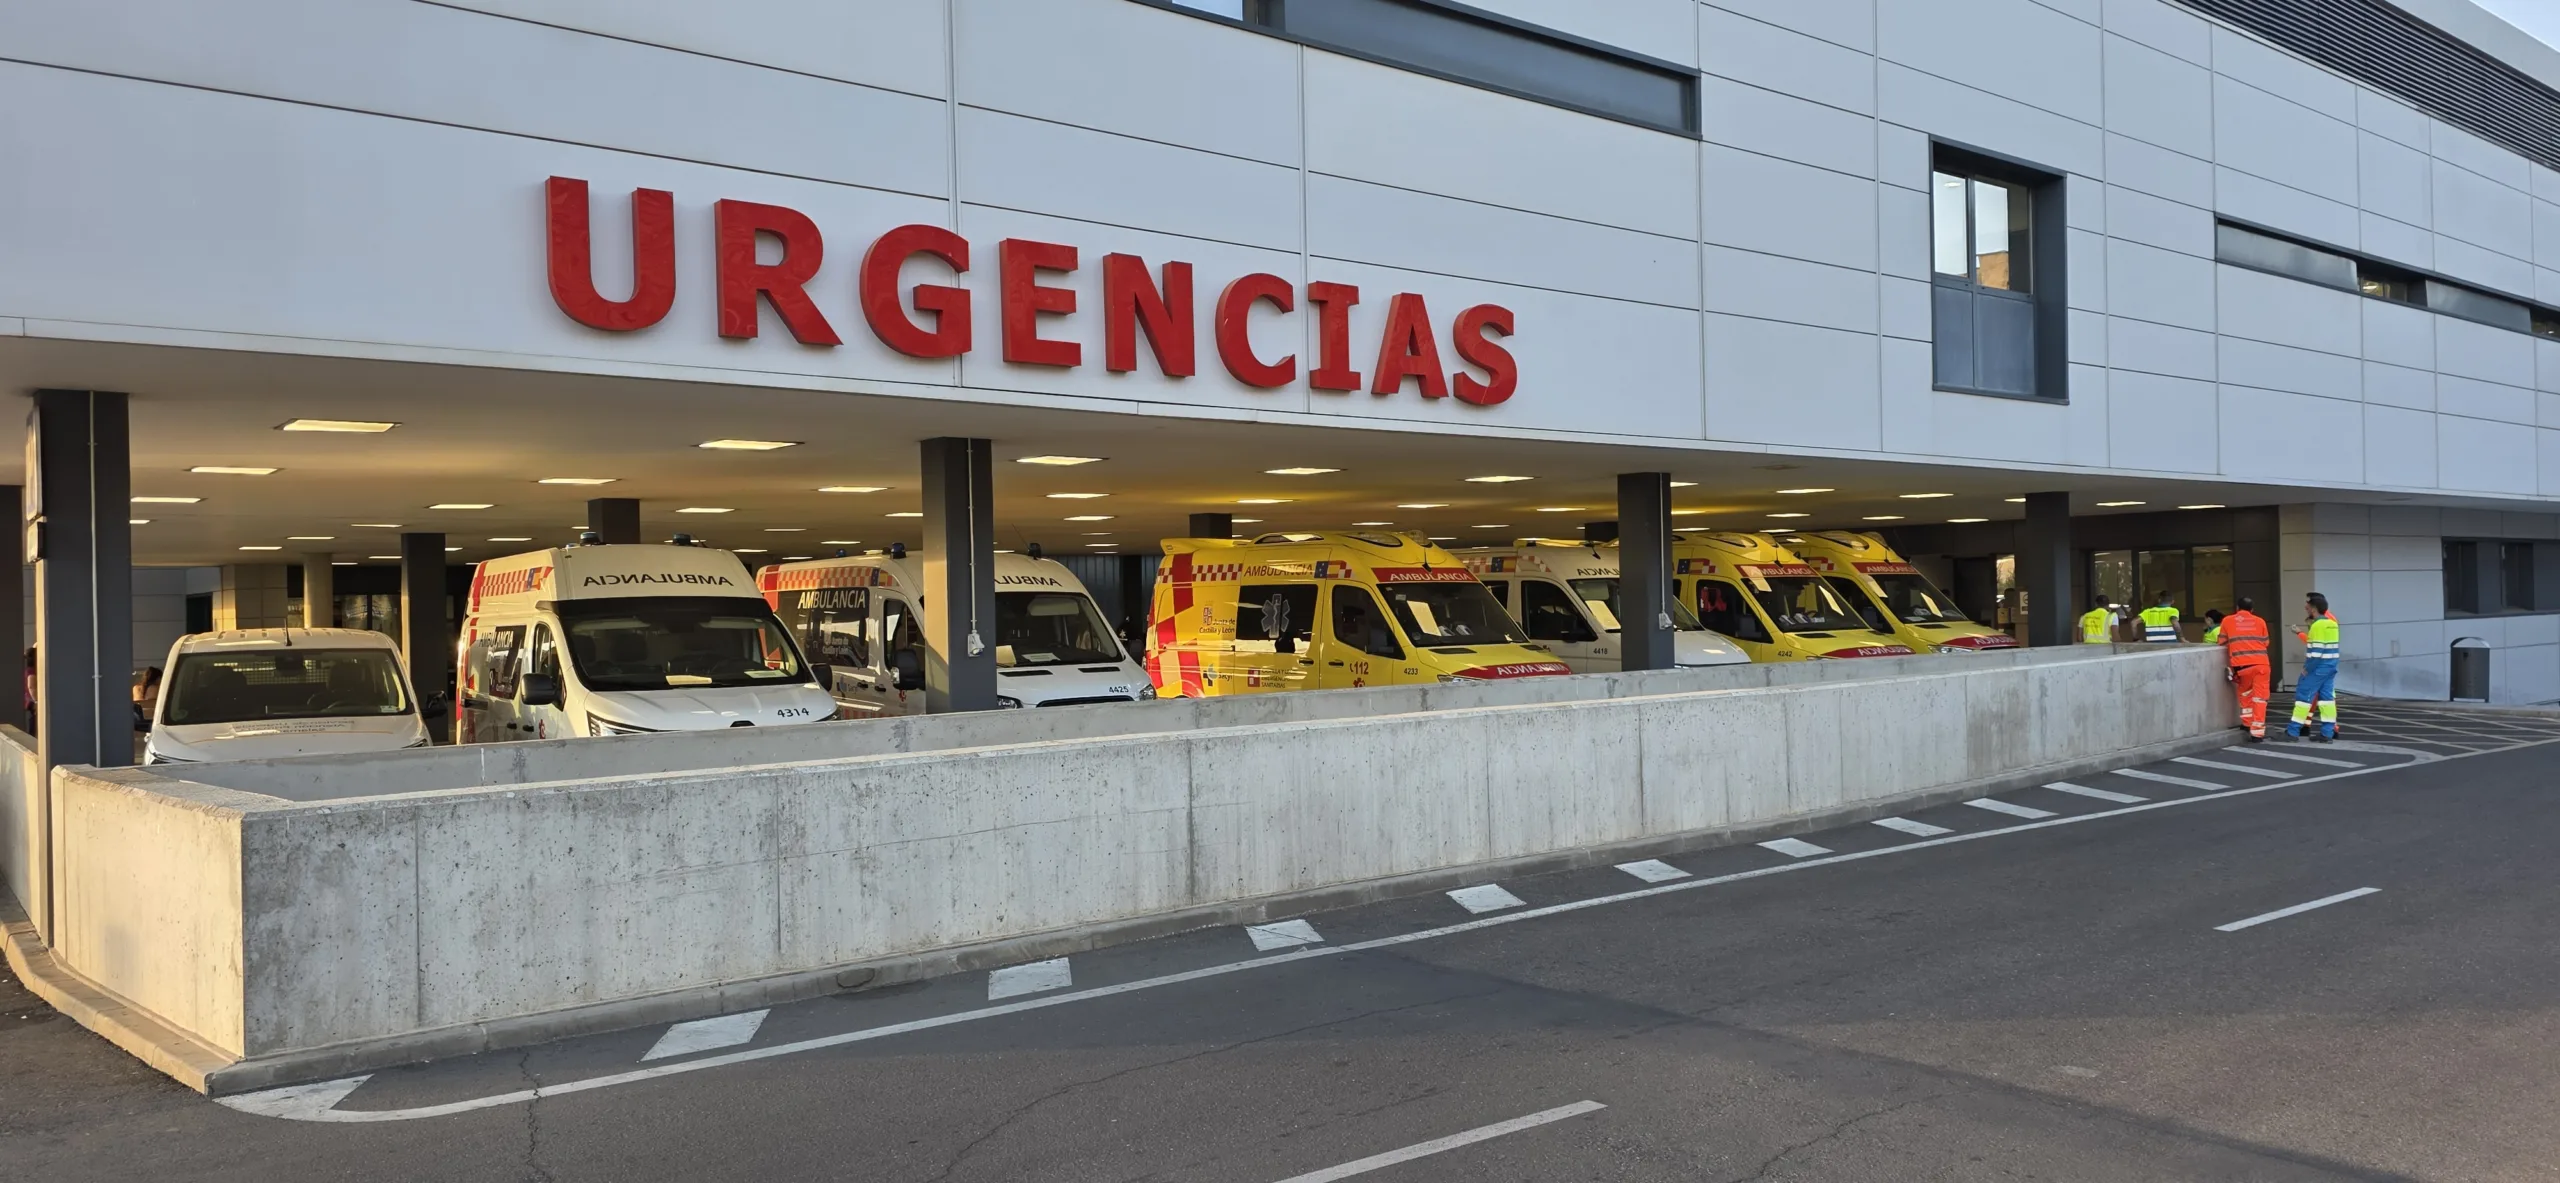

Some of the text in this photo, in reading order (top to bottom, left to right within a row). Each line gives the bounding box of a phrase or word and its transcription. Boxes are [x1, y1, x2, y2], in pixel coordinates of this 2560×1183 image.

[544, 175, 1518, 405] URGENCIAS
[1390, 573, 1472, 581] AMBULANCIA
[797, 590, 866, 610] AMBULANCIA
[1354, 662, 1369, 674] 112
[777, 707, 809, 717] 4314
